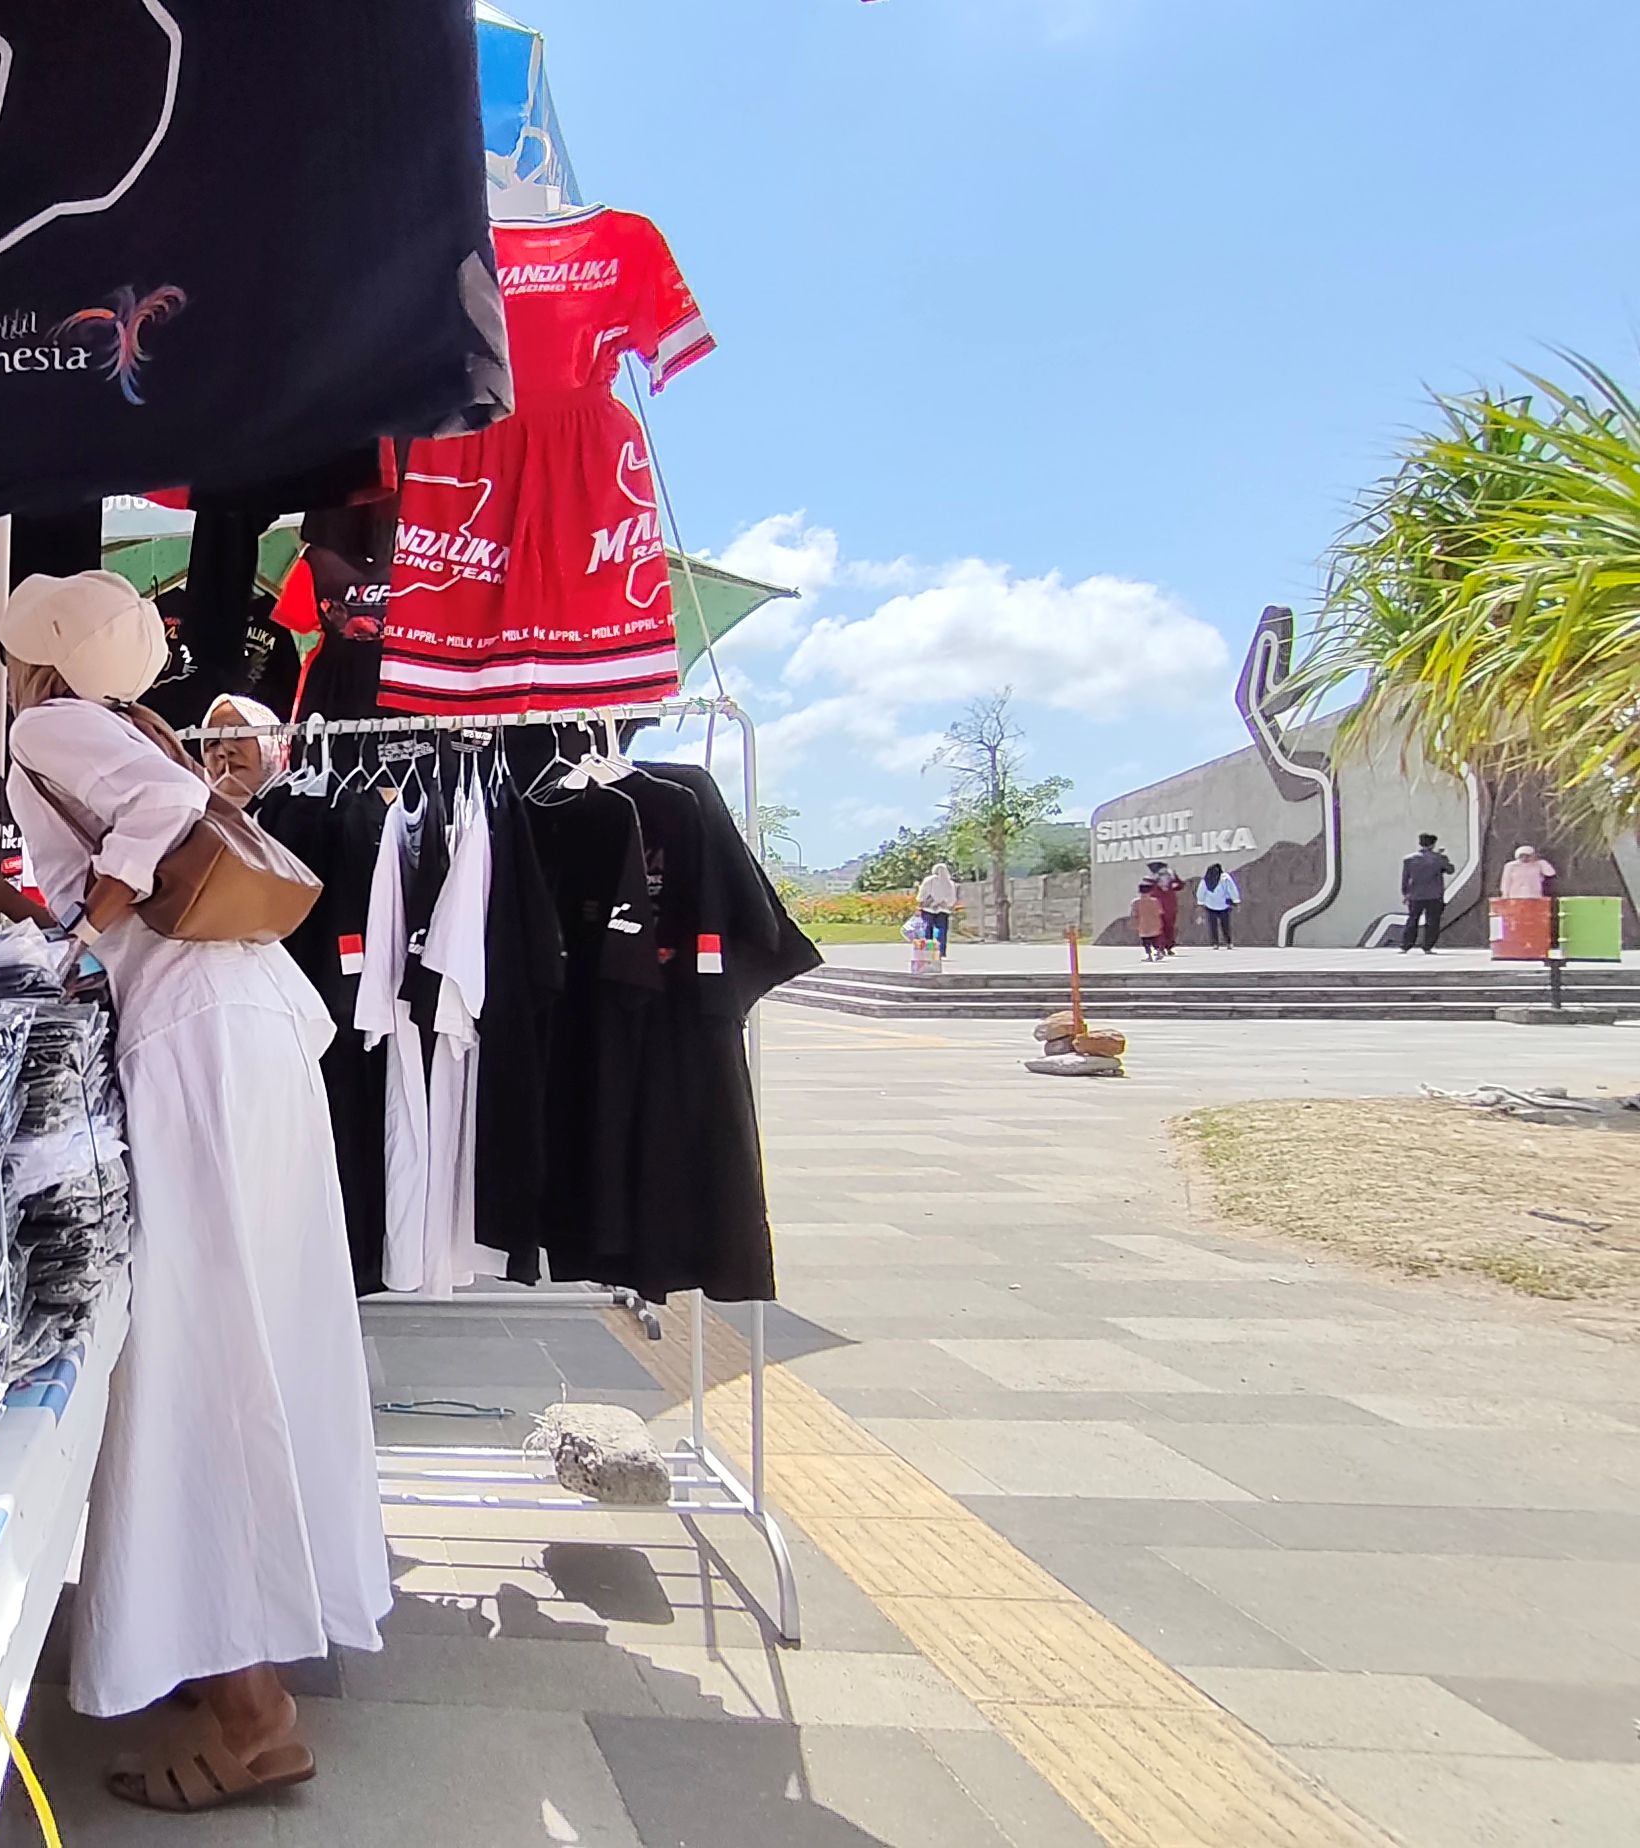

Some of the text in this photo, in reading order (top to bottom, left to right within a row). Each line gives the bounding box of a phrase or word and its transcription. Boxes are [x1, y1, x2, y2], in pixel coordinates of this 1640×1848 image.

[504, 276, 618, 297] RACING TEAM
[394, 522, 511, 573] NDALIKA
[632, 541, 663, 560] RA
[392, 553, 444, 572] CING
[246, 626, 277, 651] ALIKA
[1096, 809, 1193, 841] SIRKUIT
[1096, 827, 1258, 864] MANDALIKA
